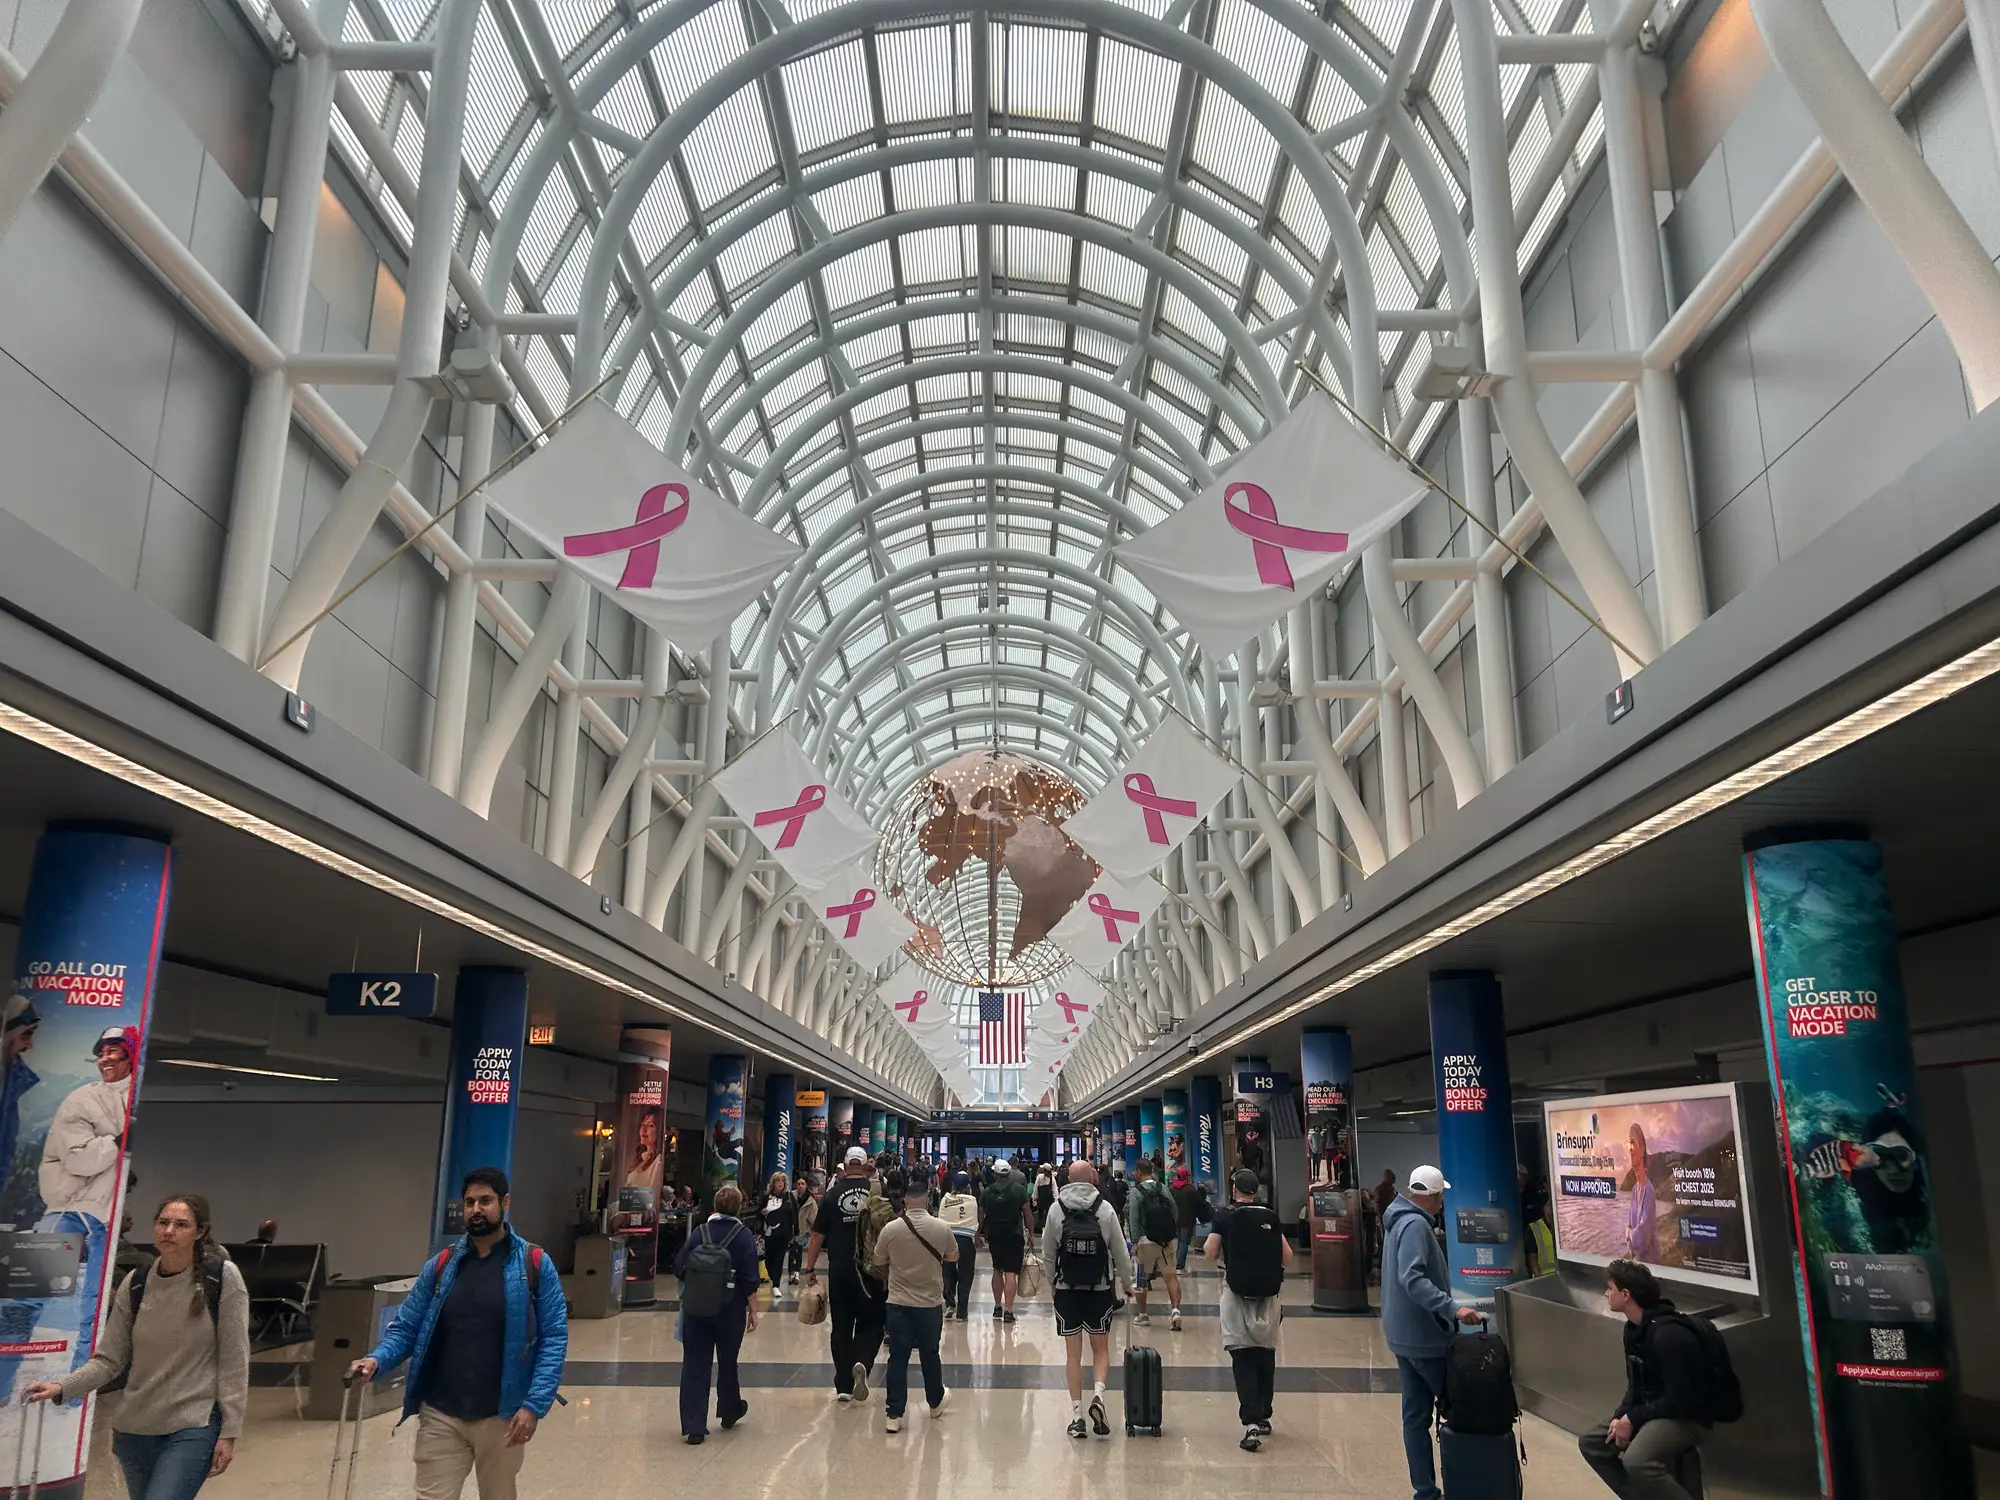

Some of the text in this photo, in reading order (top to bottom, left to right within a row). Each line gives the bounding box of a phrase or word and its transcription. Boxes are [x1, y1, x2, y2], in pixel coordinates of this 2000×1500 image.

[28, 961, 127, 978] GO ALL OUT
[20, 975, 124, 992] IN VACATION
[1785, 977, 1816, 992] GET
[67, 991, 121, 1007] MODE
[359, 981, 402, 1007] K2
[1787, 990, 1878, 1007] CLOSER TO
[1788, 1005, 1877, 1021] VACATION
[532, 1026, 551, 1040] EXIT
[1792, 1020, 1845, 1037] MODE
[477, 1048, 512, 1059] APPLY
[472, 1058, 511, 1070] TODAY
[1443, 1055, 1476, 1066] APPLY
[475, 1069, 511, 1080] FOR A
[1443, 1066, 1482, 1077] TODAY
[468, 1080, 510, 1092] BONUS
[1254, 1076, 1274, 1089] H3
[1444, 1077, 1480, 1088] FOR A
[471, 1091, 509, 1103] OFFER
[1445, 1088, 1488, 1100] BONUS
[1446, 1099, 1483, 1111] OFFER
[777, 1110, 790, 1169] TRAVEL ON
[1199, 1113, 1212, 1173] TRAVEL ON
[1672, 1167, 1715, 1179] Visit booth 1816
[1565, 1180, 1611, 1194] NOW APPROVED
[1674, 1182, 1715, 1194] at CHEST 2025
[1680, 1197, 1690, 1205] learn
[1701, 1199, 1713, 1207] about
[1830, 1260, 1913, 1274] citi AAdvantage
[1842, 1365, 1940, 1379] ApplyAACard.com/airport
